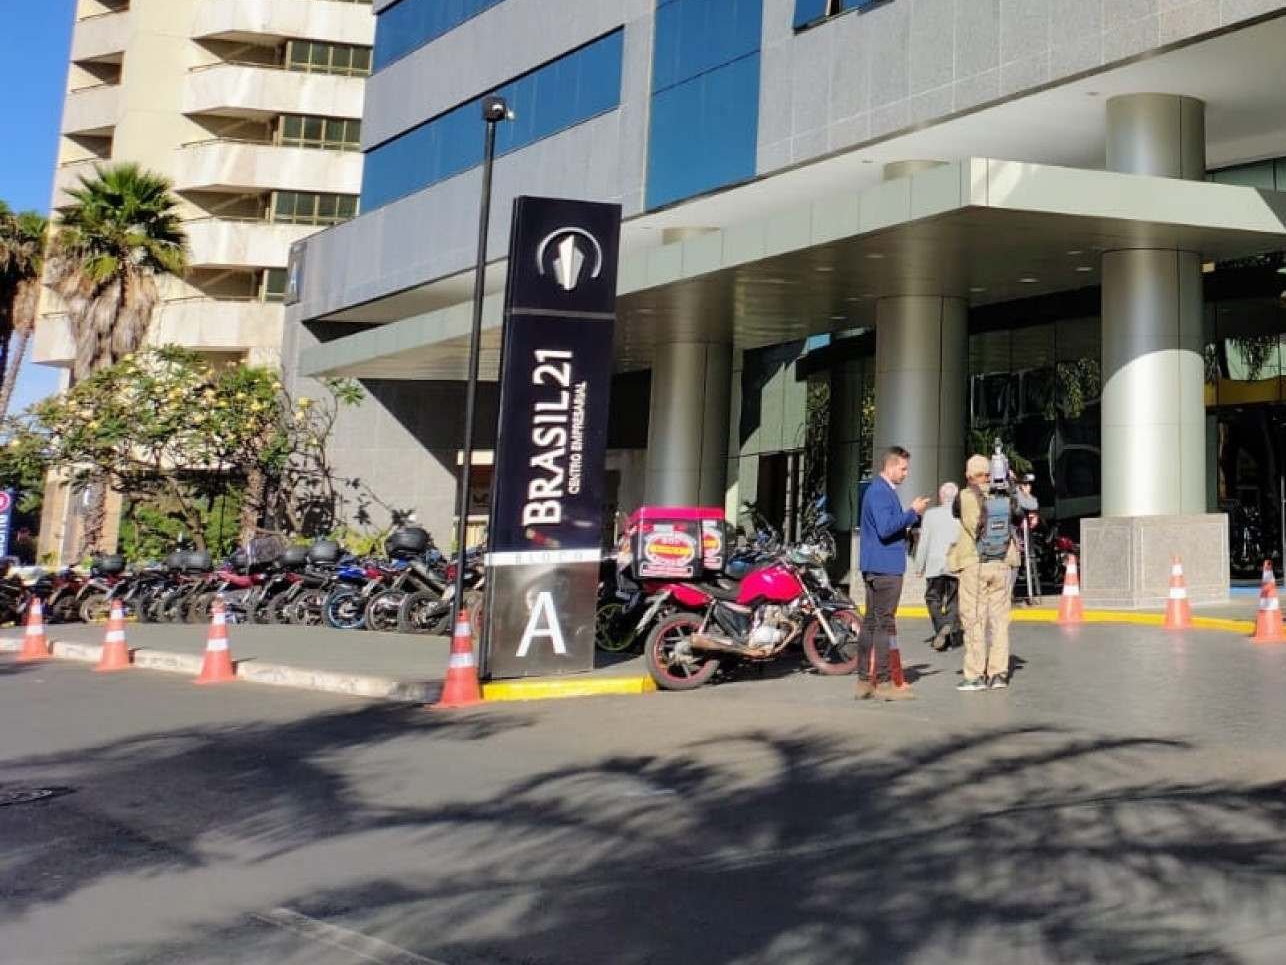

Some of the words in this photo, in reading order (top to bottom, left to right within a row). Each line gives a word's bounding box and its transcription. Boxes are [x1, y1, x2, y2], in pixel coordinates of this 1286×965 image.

[533, 349, 574, 387] 21
[571, 380, 588, 452] EMPRESARIAL
[522, 389, 570, 527] BRASIL
[568, 453, 583, 495] CENTRO
[516, 591, 567, 657] A
